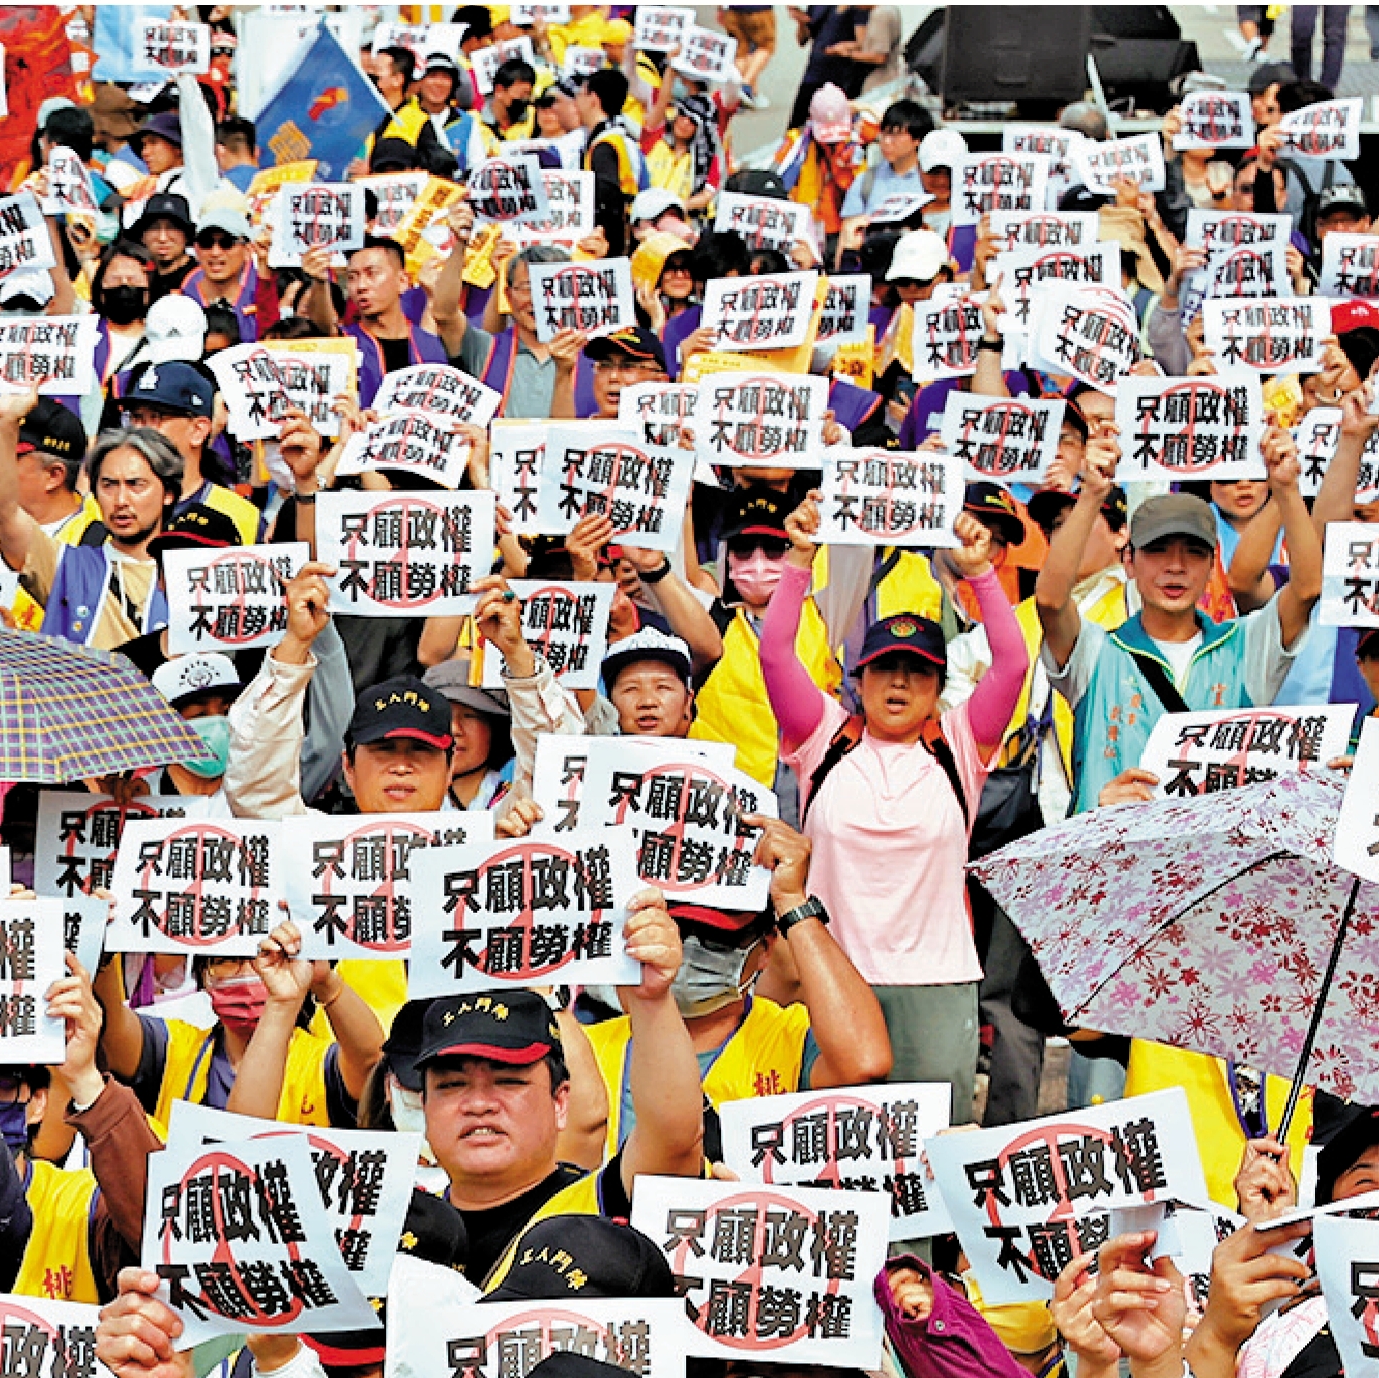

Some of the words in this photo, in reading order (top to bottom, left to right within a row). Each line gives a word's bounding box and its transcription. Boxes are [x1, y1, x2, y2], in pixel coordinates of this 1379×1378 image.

[712, 384, 811, 422] 只顧政權
[959, 408, 1049, 444] 只顧政權
[1134, 386, 1249, 428] 只顧政權
[710, 421, 808, 453] 不顧勞權
[955, 438, 1040, 473] 不顧勞權
[1132, 432, 1248, 473] 不顧勞權
[562, 449, 671, 501] 只顧政權
[834, 457, 946, 496] 只顧政權
[340, 505, 473, 554] 只顧政權
[832, 497, 946, 533] 不顧勞權
[339, 559, 472, 603] 不顧勞權
[1174, 715, 1327, 763] 只顧政權
[608, 770, 758, 838] 只顧政權
[136, 834, 269, 889] 只顧政權
[443, 845, 614, 913] 只顧政權
[130, 889, 269, 938] 不顧勞權
[442, 923, 612, 980] 不顧勞權
[750, 1100, 919, 1169] 只顧政權
[964, 1118, 1167, 1210] 只顧政權
[159, 1160, 308, 1242] 只顧政權
[662, 1206, 857, 1281] 只顧政權
[156, 1261, 337, 1321] 不顧勞權
